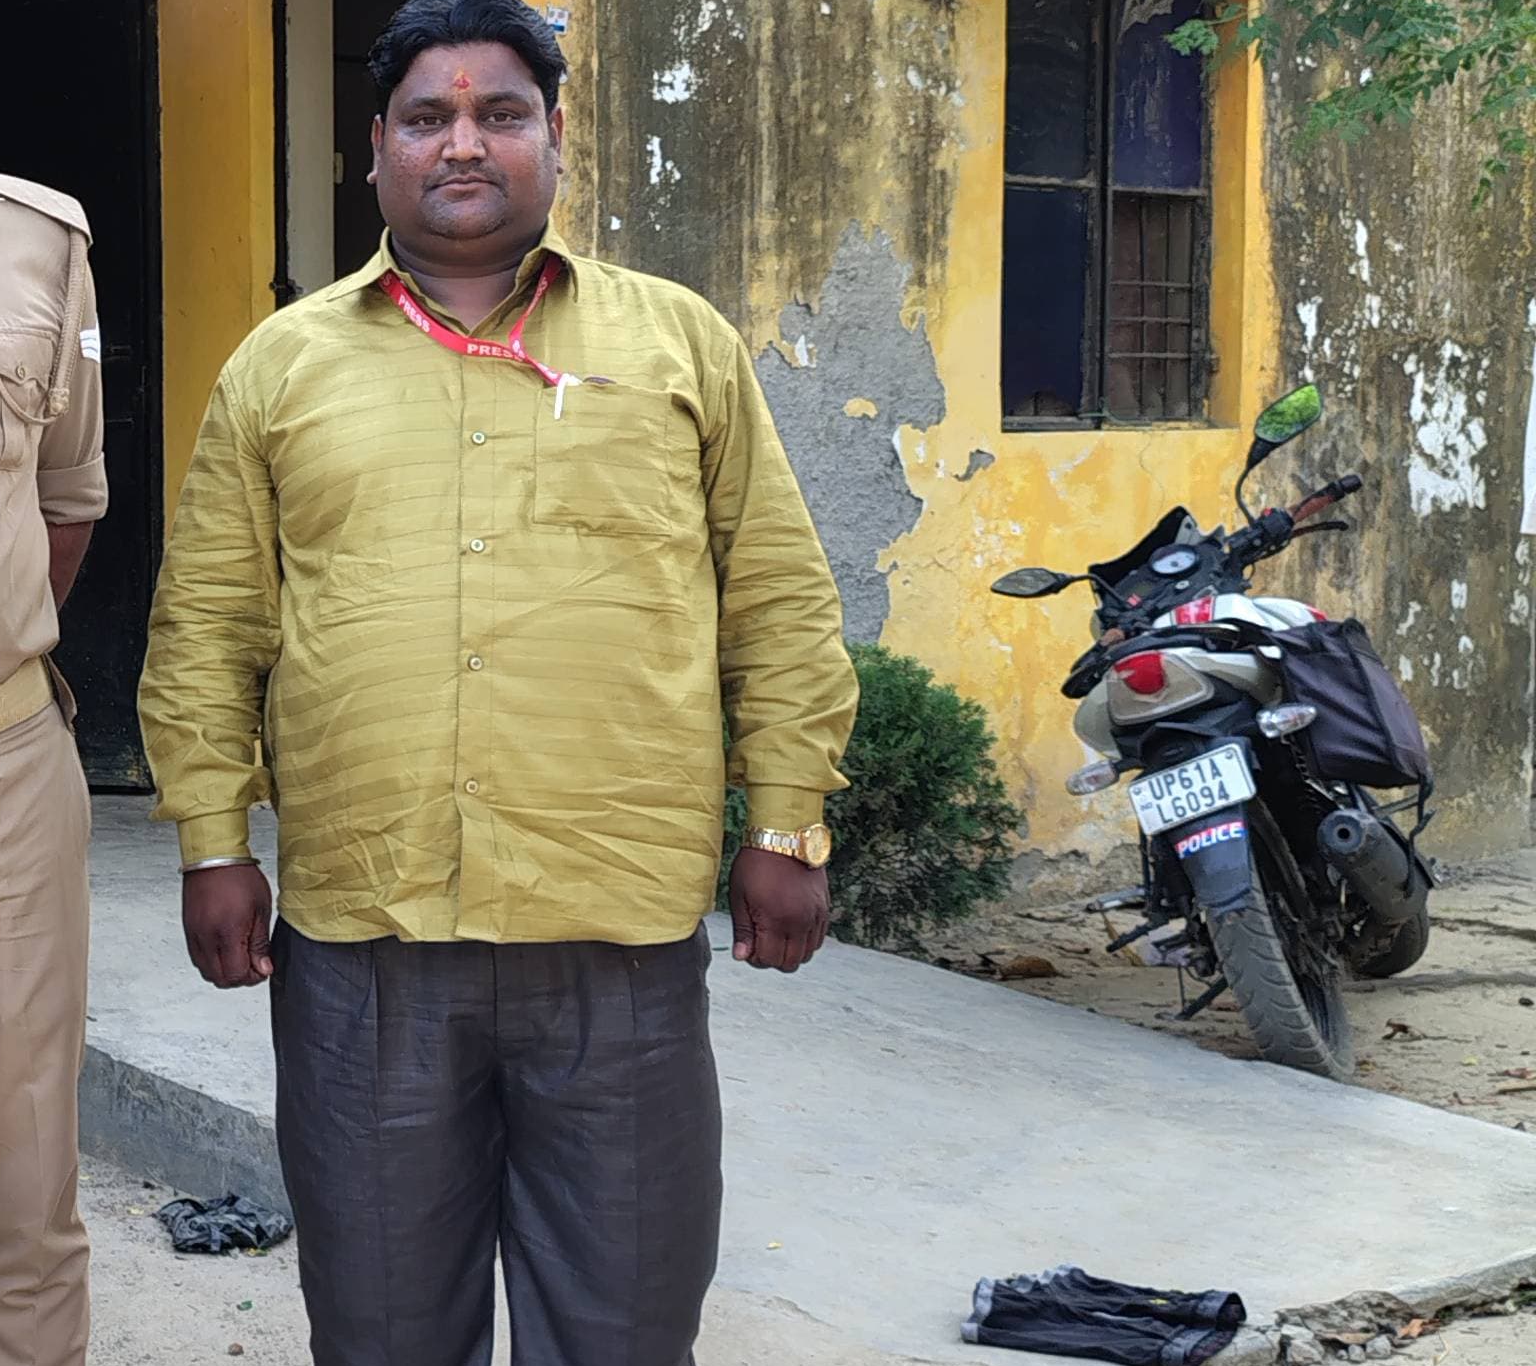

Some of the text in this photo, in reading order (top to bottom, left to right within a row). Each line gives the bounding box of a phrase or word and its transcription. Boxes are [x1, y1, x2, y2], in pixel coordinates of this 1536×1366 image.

[398, 294, 431, 333] PRESS
[1148, 758, 1222, 801] UP61A
[1156, 780, 1230, 823] L6094
[1175, 821, 1244, 859] POLICE
